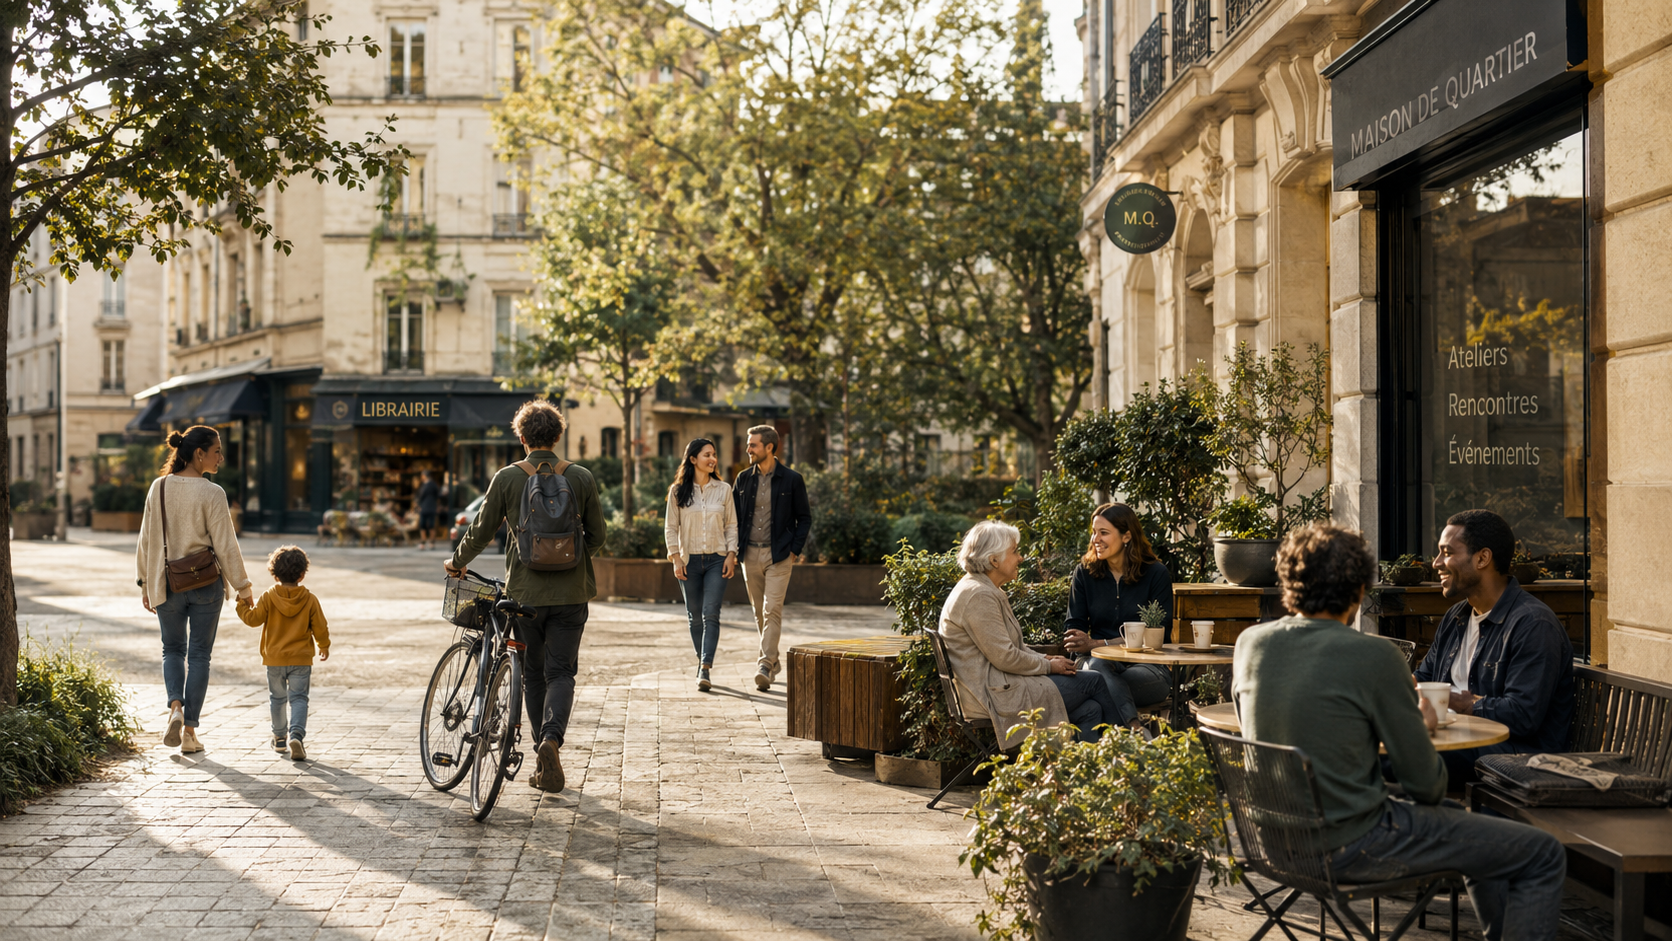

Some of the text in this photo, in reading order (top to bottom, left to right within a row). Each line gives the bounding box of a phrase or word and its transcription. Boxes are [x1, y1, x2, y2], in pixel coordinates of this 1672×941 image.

[1351, 31, 1538, 160] MAISON DE QUARTIER
[1124, 211, 1159, 228] M.Q.
[1448, 342, 1508, 369] Ateliers
[362, 402, 440, 417] LIBRAIRIE
[1449, 391, 1538, 416] Rencontres
[1449, 434, 1540, 465] Événements
